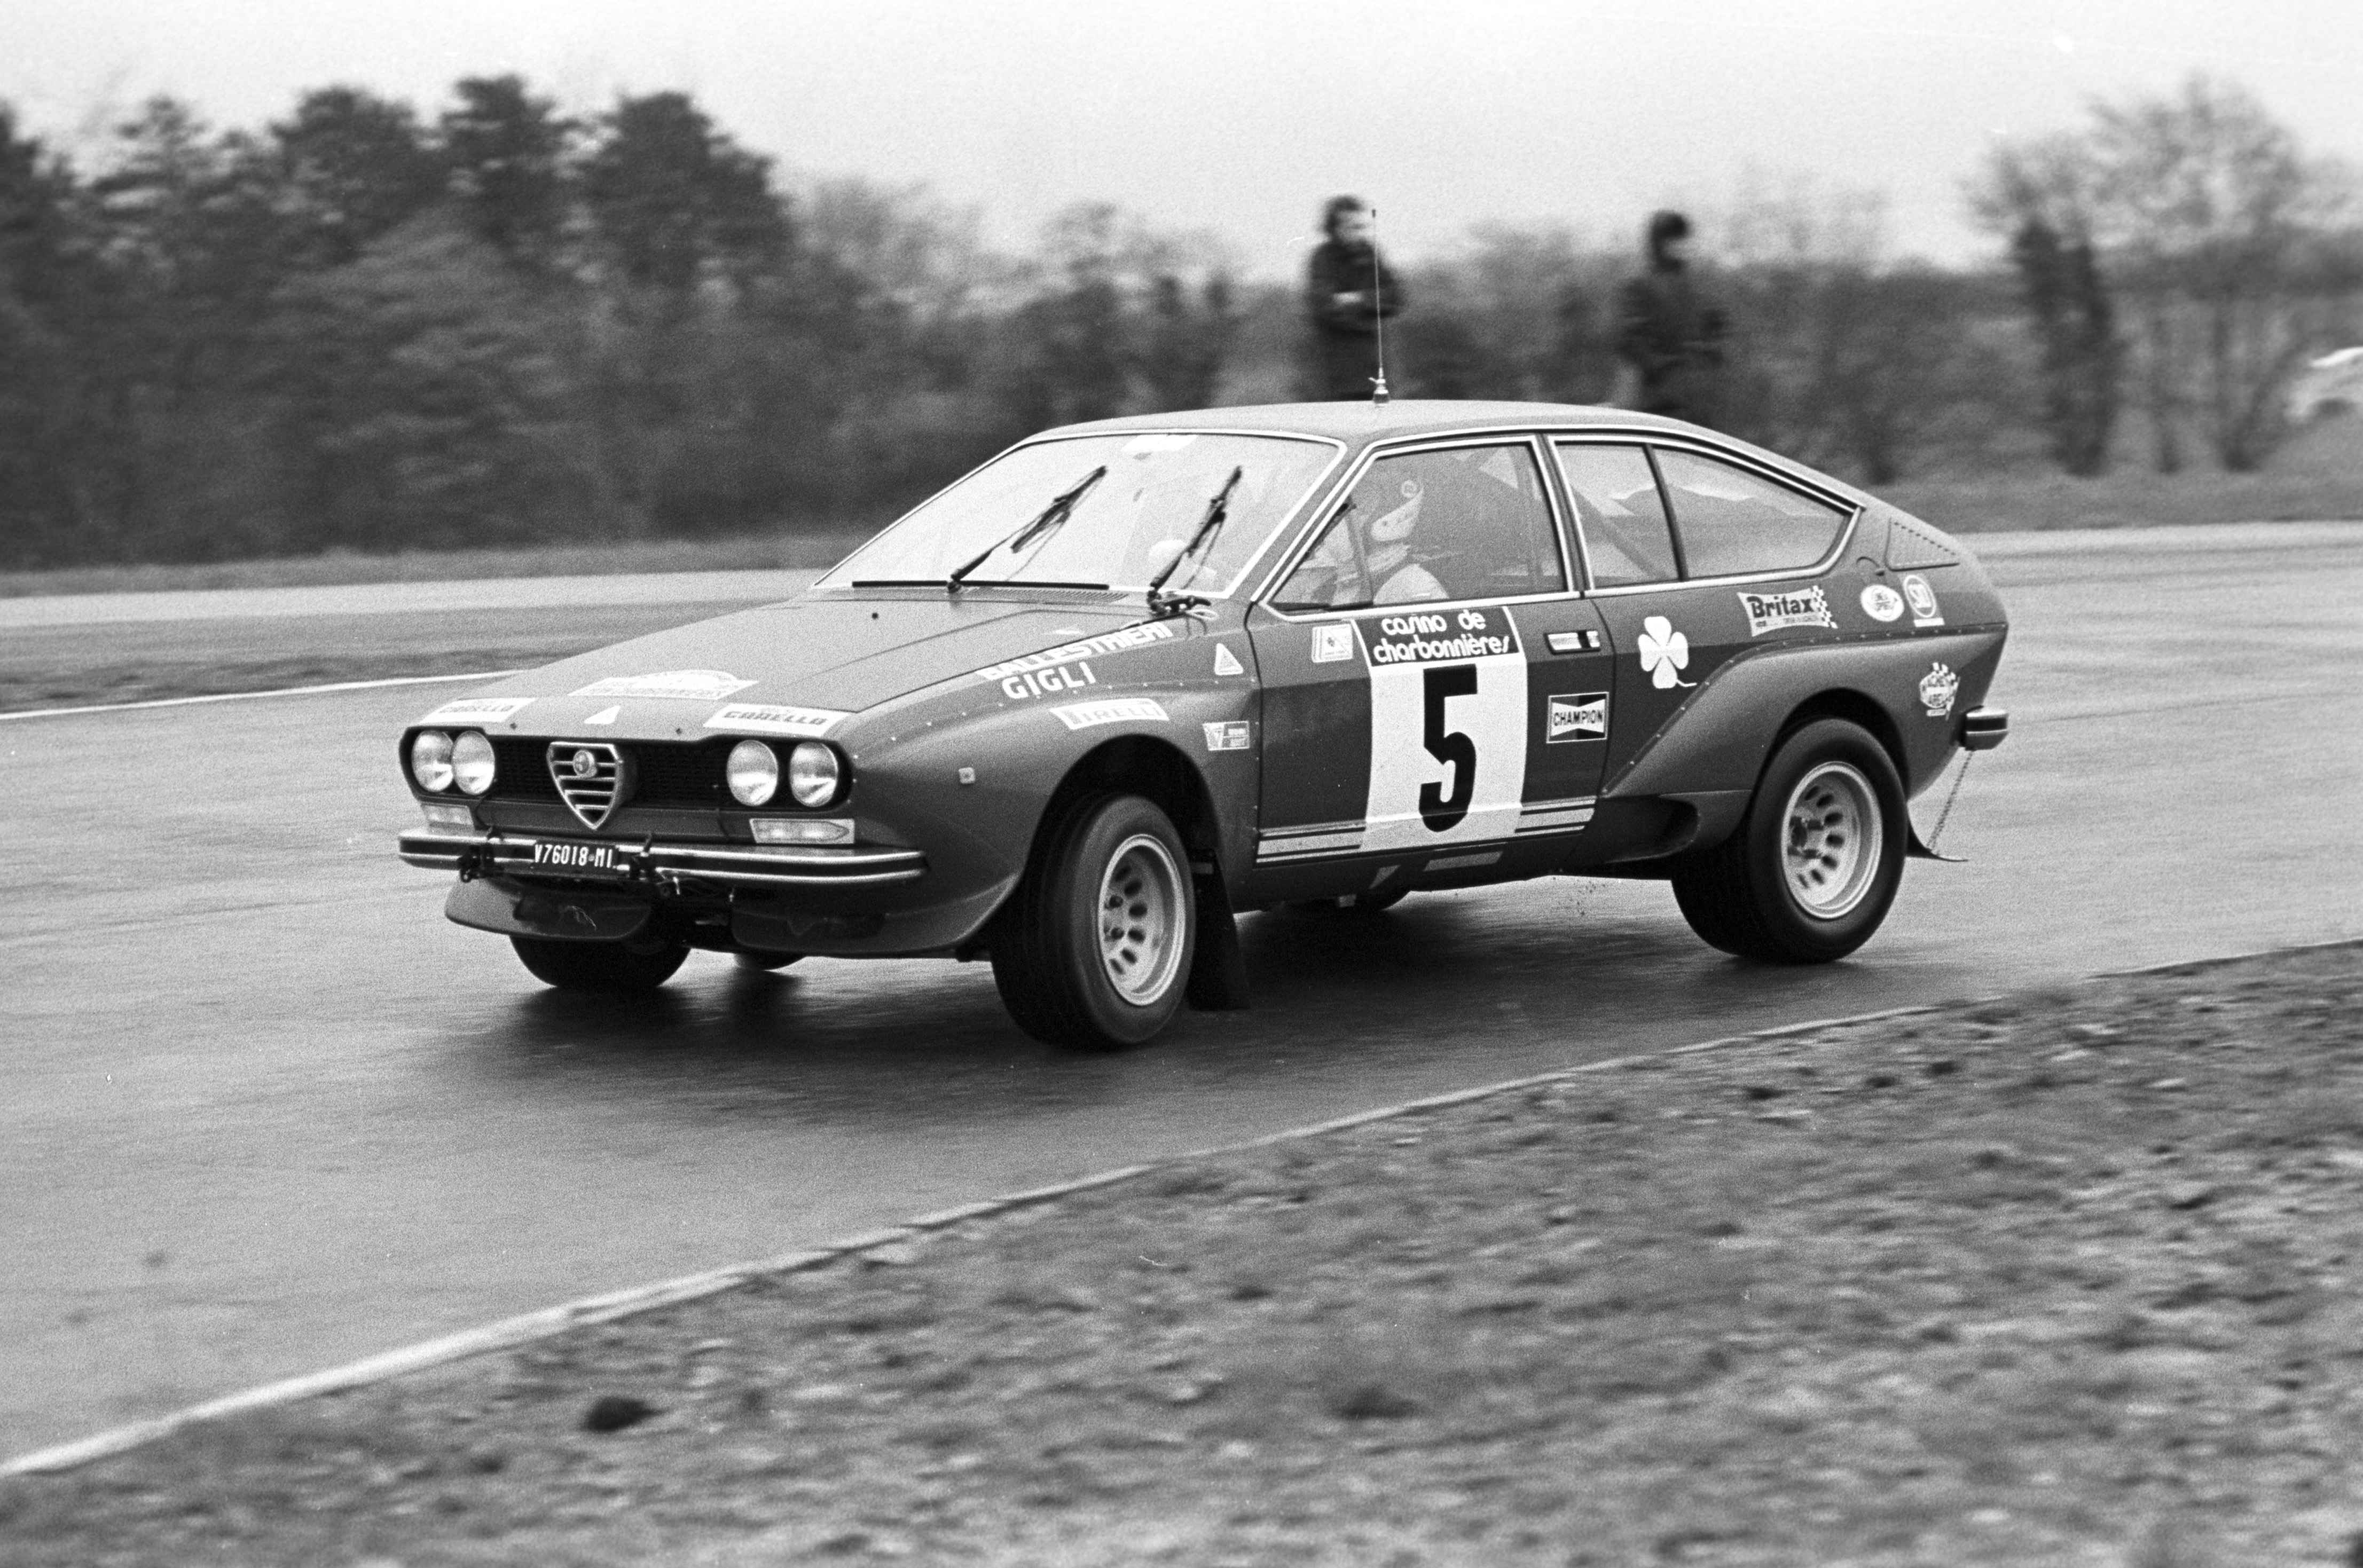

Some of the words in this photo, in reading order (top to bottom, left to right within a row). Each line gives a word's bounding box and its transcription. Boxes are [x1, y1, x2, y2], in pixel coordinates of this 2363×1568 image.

[1746, 595, 1815, 618] Britax
[1381, 614, 1447, 635] casino
[1457, 609, 1486, 630] de
[975, 622, 1173, 680] BALLESTRIERI
[1373, 633, 1509, 663] charbonnières
[1002, 661, 1096, 699] GIGLI
[723, 710, 828, 726] CARELLO
[1553, 709, 1603, 727] CHAMPION
[1418, 664, 1478, 832] 5
